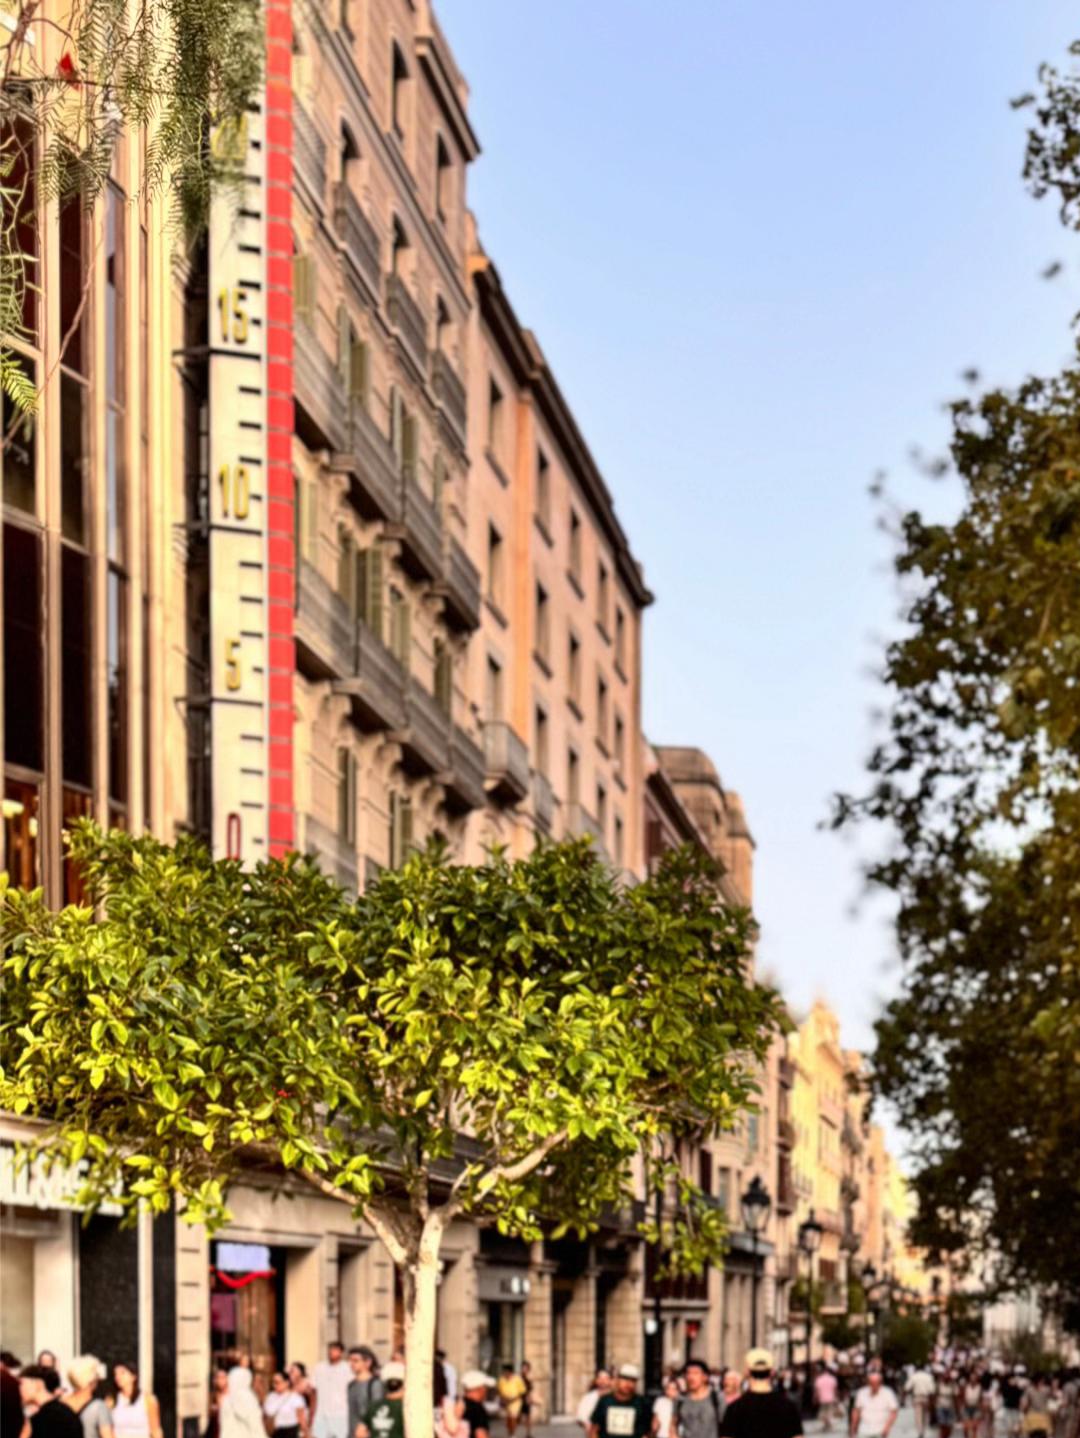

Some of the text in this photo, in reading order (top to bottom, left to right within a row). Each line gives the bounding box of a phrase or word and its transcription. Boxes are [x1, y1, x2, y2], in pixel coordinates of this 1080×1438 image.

[218, 287, 249, 345] 15
[219, 463, 250, 520] 10
[225, 637, 242, 691] 5
[227, 811, 241, 861] 0
